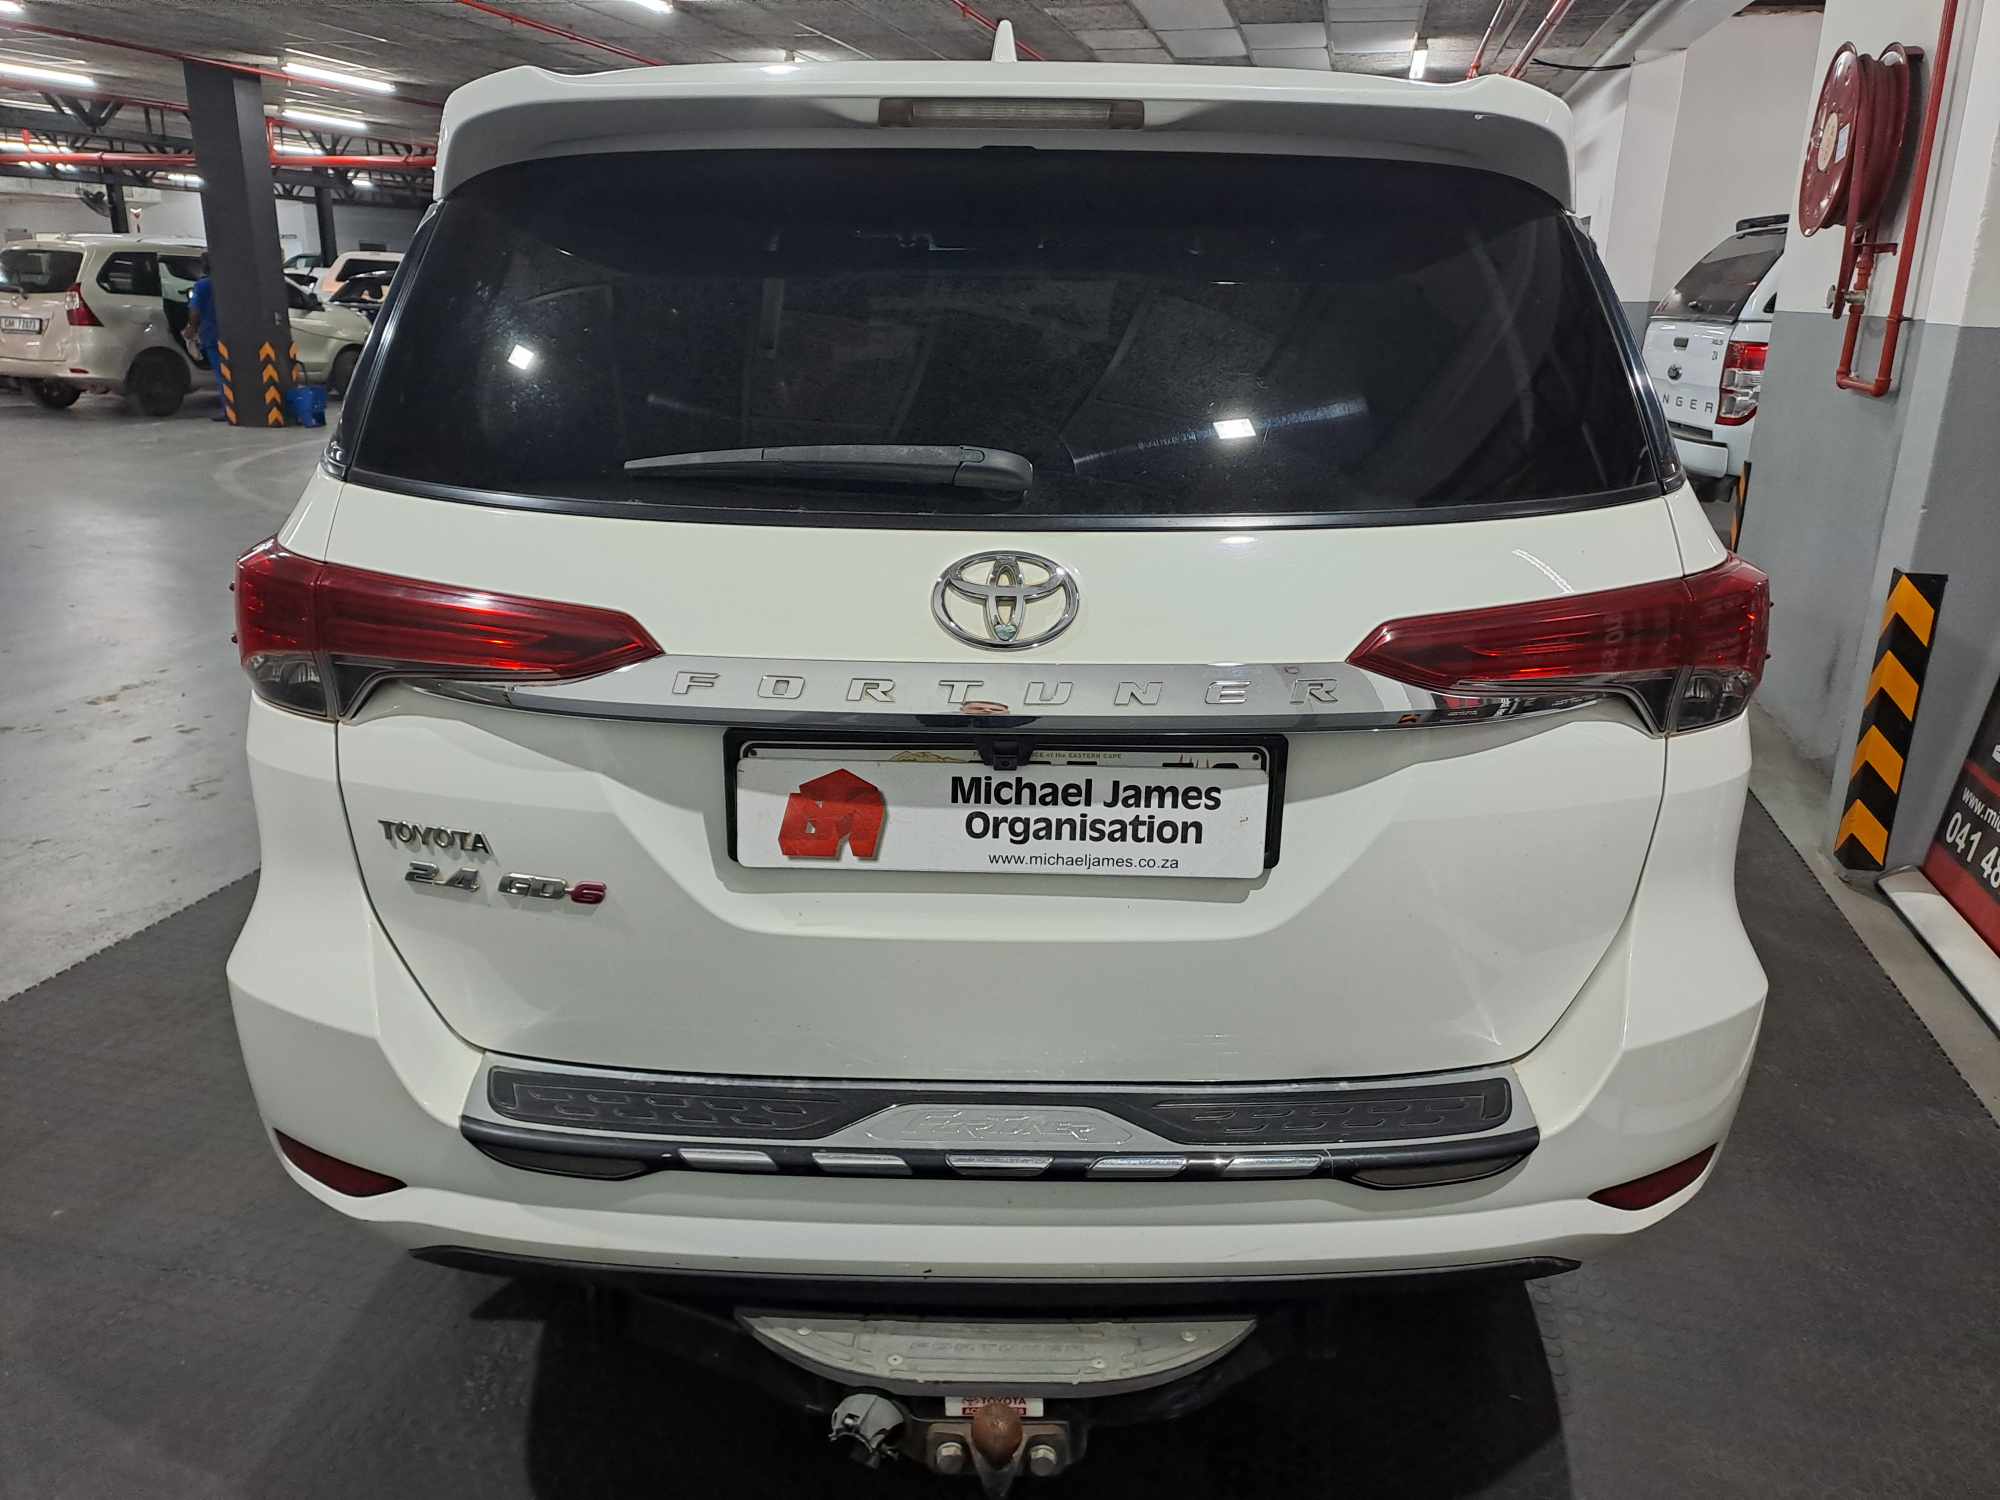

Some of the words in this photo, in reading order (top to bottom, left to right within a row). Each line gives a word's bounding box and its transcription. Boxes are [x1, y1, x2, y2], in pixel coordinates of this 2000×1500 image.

[1662, 391, 1715, 414] NGER
[671, 670, 1339, 706] FORTUNER
[1067, 752, 1101, 760] EASTERN
[950, 775, 1093, 807] Michael
[1103, 780, 1222, 811] James
[377, 819, 494, 856] TOYOTA
[965, 811, 1203, 845] Organisation
[1945, 811, 1982, 863] 041
[988, 852, 1179, 869] www.michaeljames.co.za
[497, 871, 608, 905] GD-6
